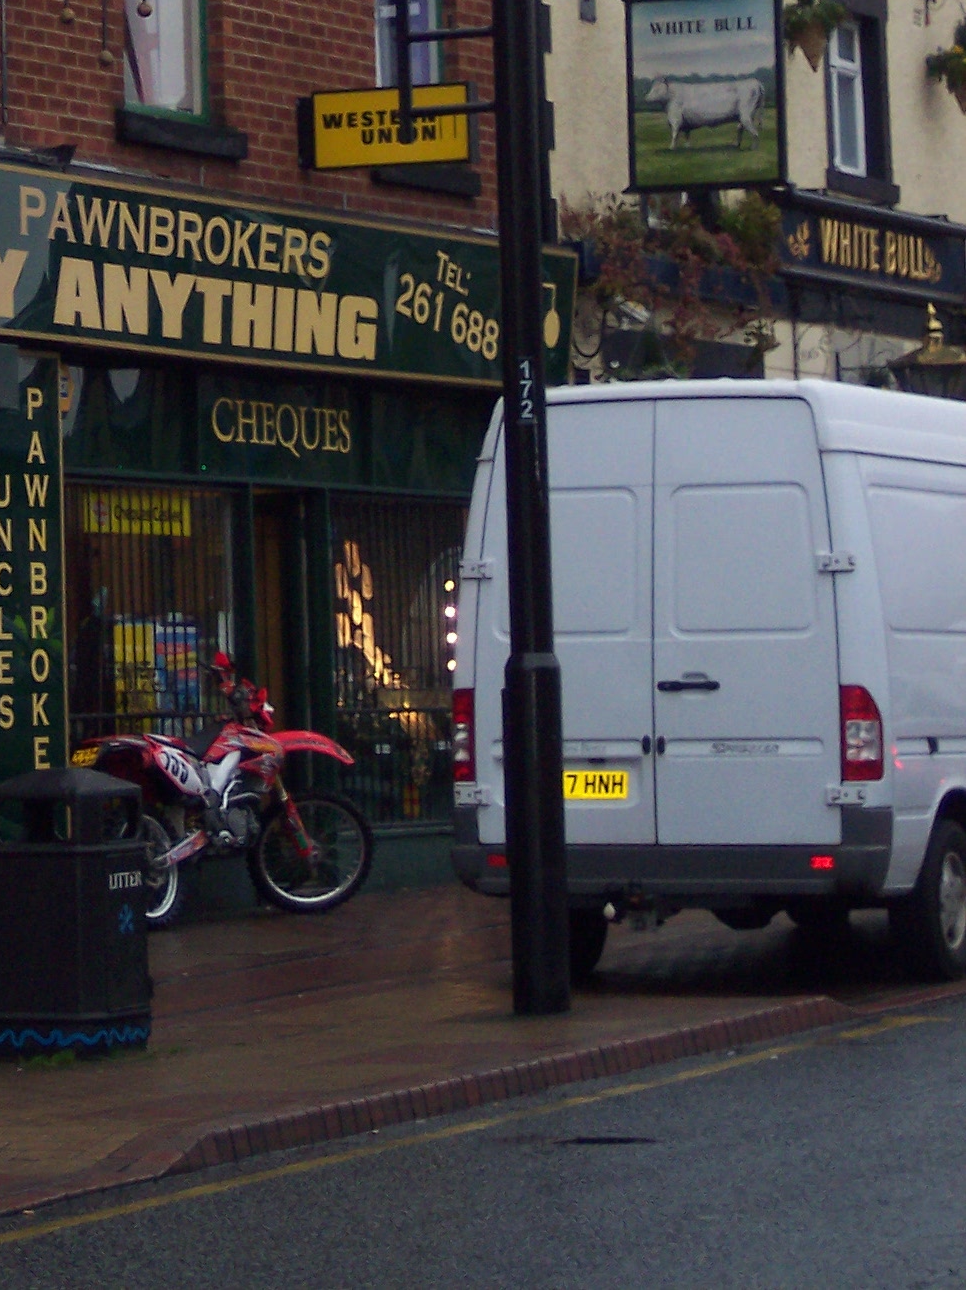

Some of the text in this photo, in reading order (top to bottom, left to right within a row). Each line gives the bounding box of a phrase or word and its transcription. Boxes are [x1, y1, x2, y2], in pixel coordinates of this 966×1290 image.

[649, 16, 757, 35] WHITE BULL
[361, 124, 438, 145] UNN
[19, 185, 333, 280] PAWNBROKERS
[819, 217, 881, 271] WHITE
[53, 257, 379, 361] ANYTHING
[395, 273, 500, 361] 261 688
[519, 360, 534, 419] 172
[210, 397, 352, 457] CHEQUES
[23, 386, 52, 771] PAWNBROKE
[584, 774, 625, 795] HNH
